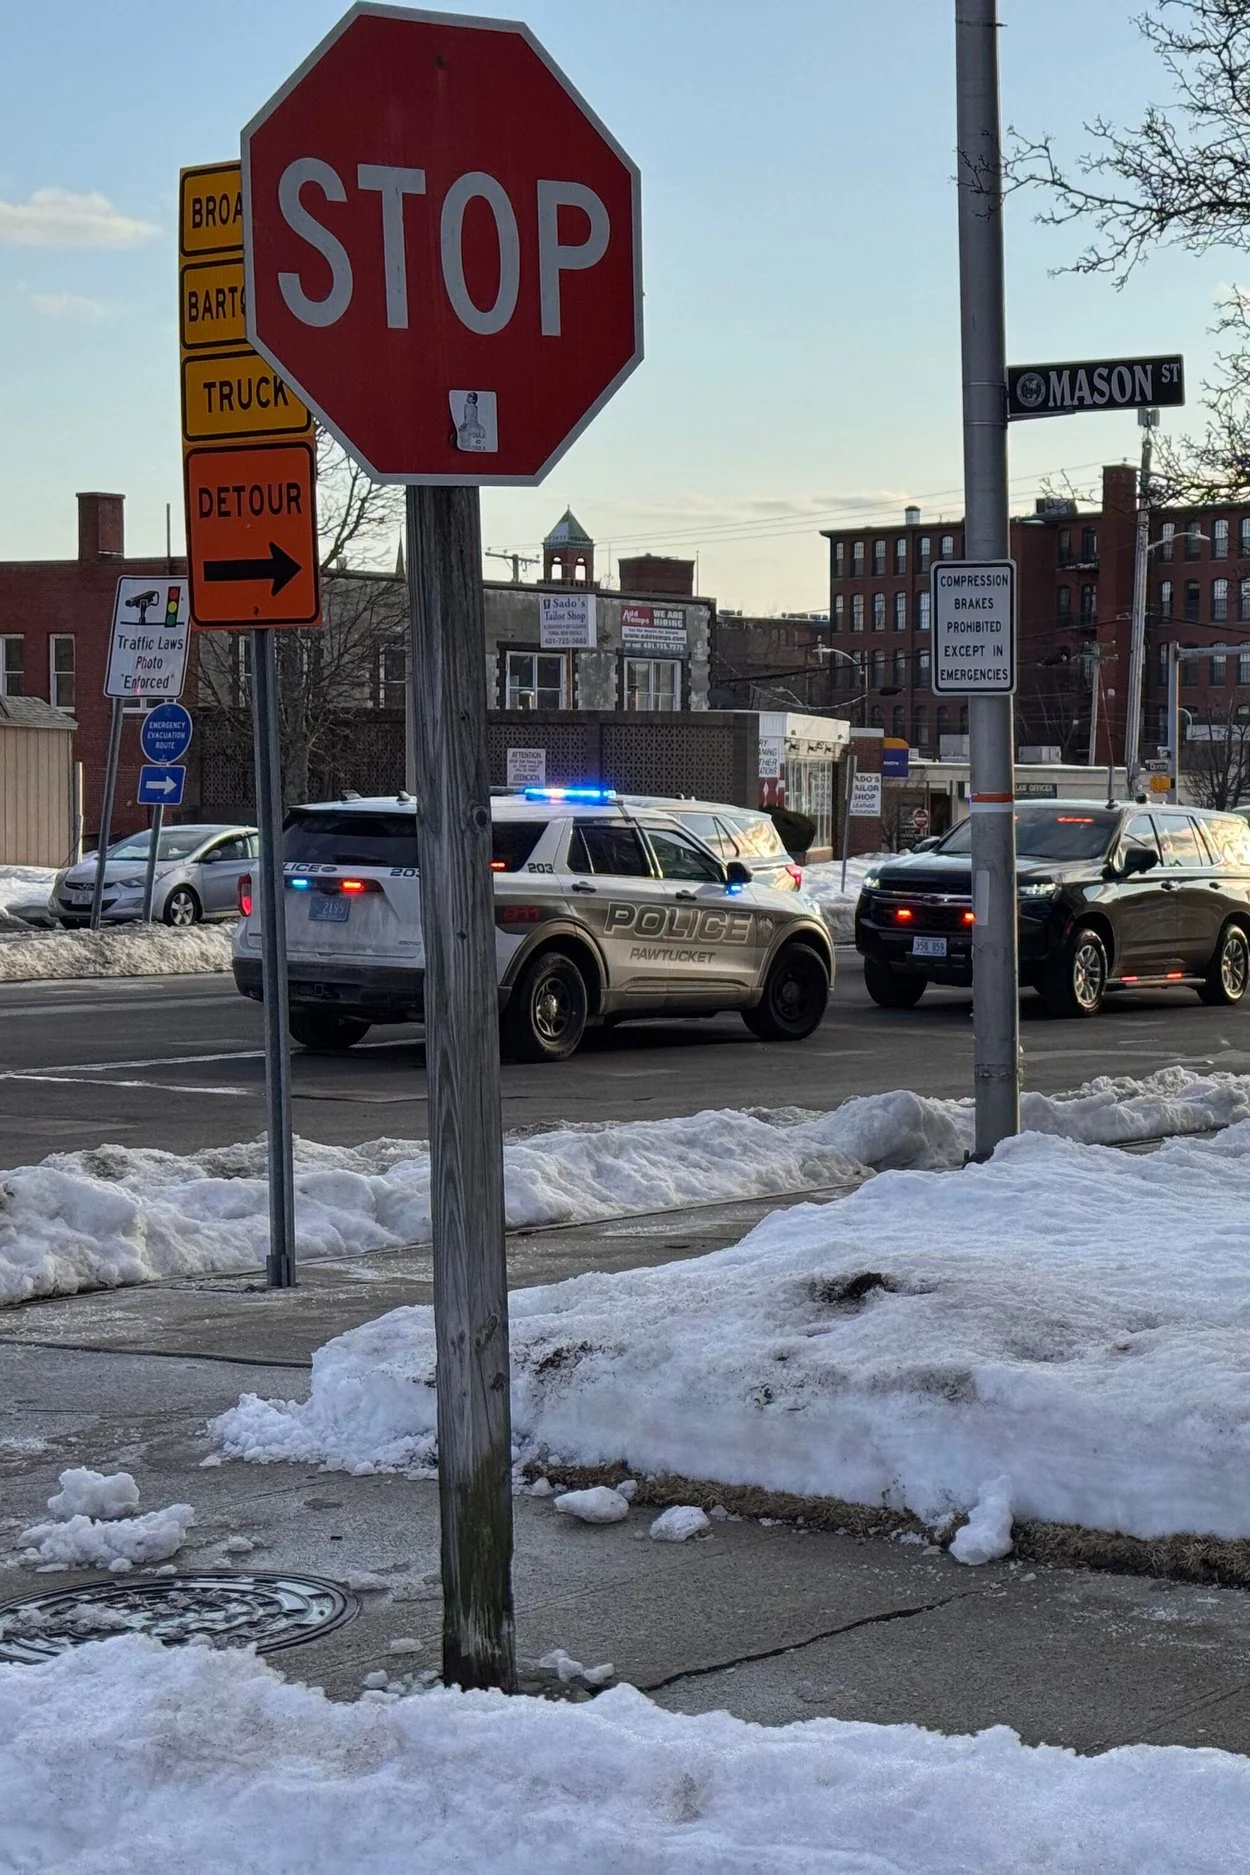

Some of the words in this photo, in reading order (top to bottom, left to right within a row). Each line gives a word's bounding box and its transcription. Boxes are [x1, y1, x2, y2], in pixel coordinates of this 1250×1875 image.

[277, 157, 611, 337] STOP
[1048, 363, 1153, 407] MASON
[1160, 363, 1180, 383] ST
[202, 374, 290, 414] TRUCK
[198, 482, 303, 519] DETOUR
[940, 574, 1009, 587] COMPRESSION
[552, 597, 586, 608] Sado's
[954, 598, 994, 610] BRAKES
[544, 610, 566, 621] Tailor
[566, 610, 587, 623] Shop
[653, 609, 666, 618] WE
[667, 611, 684, 619] ARE
[653, 618, 684, 628] HIRING
[946, 620, 1002, 633] PROHIBITED
[117, 634, 154, 650] Traffic
[157, 636, 184, 650] Laws
[944, 644, 986, 657] EXCEPT
[993, 644, 1004, 657] IN
[135, 655, 163, 670] Photo
[940, 668, 1009, 681] EMERGENCIES
[148, 721, 186, 729] EMERGENCY
[147, 731, 186, 740] EVACUATION
[155, 741, 175, 749] ROUTE
[527, 863, 554, 874] 203
[603, 901, 754, 944] POLICE
[629, 947, 716, 964] PAWTUCKET
